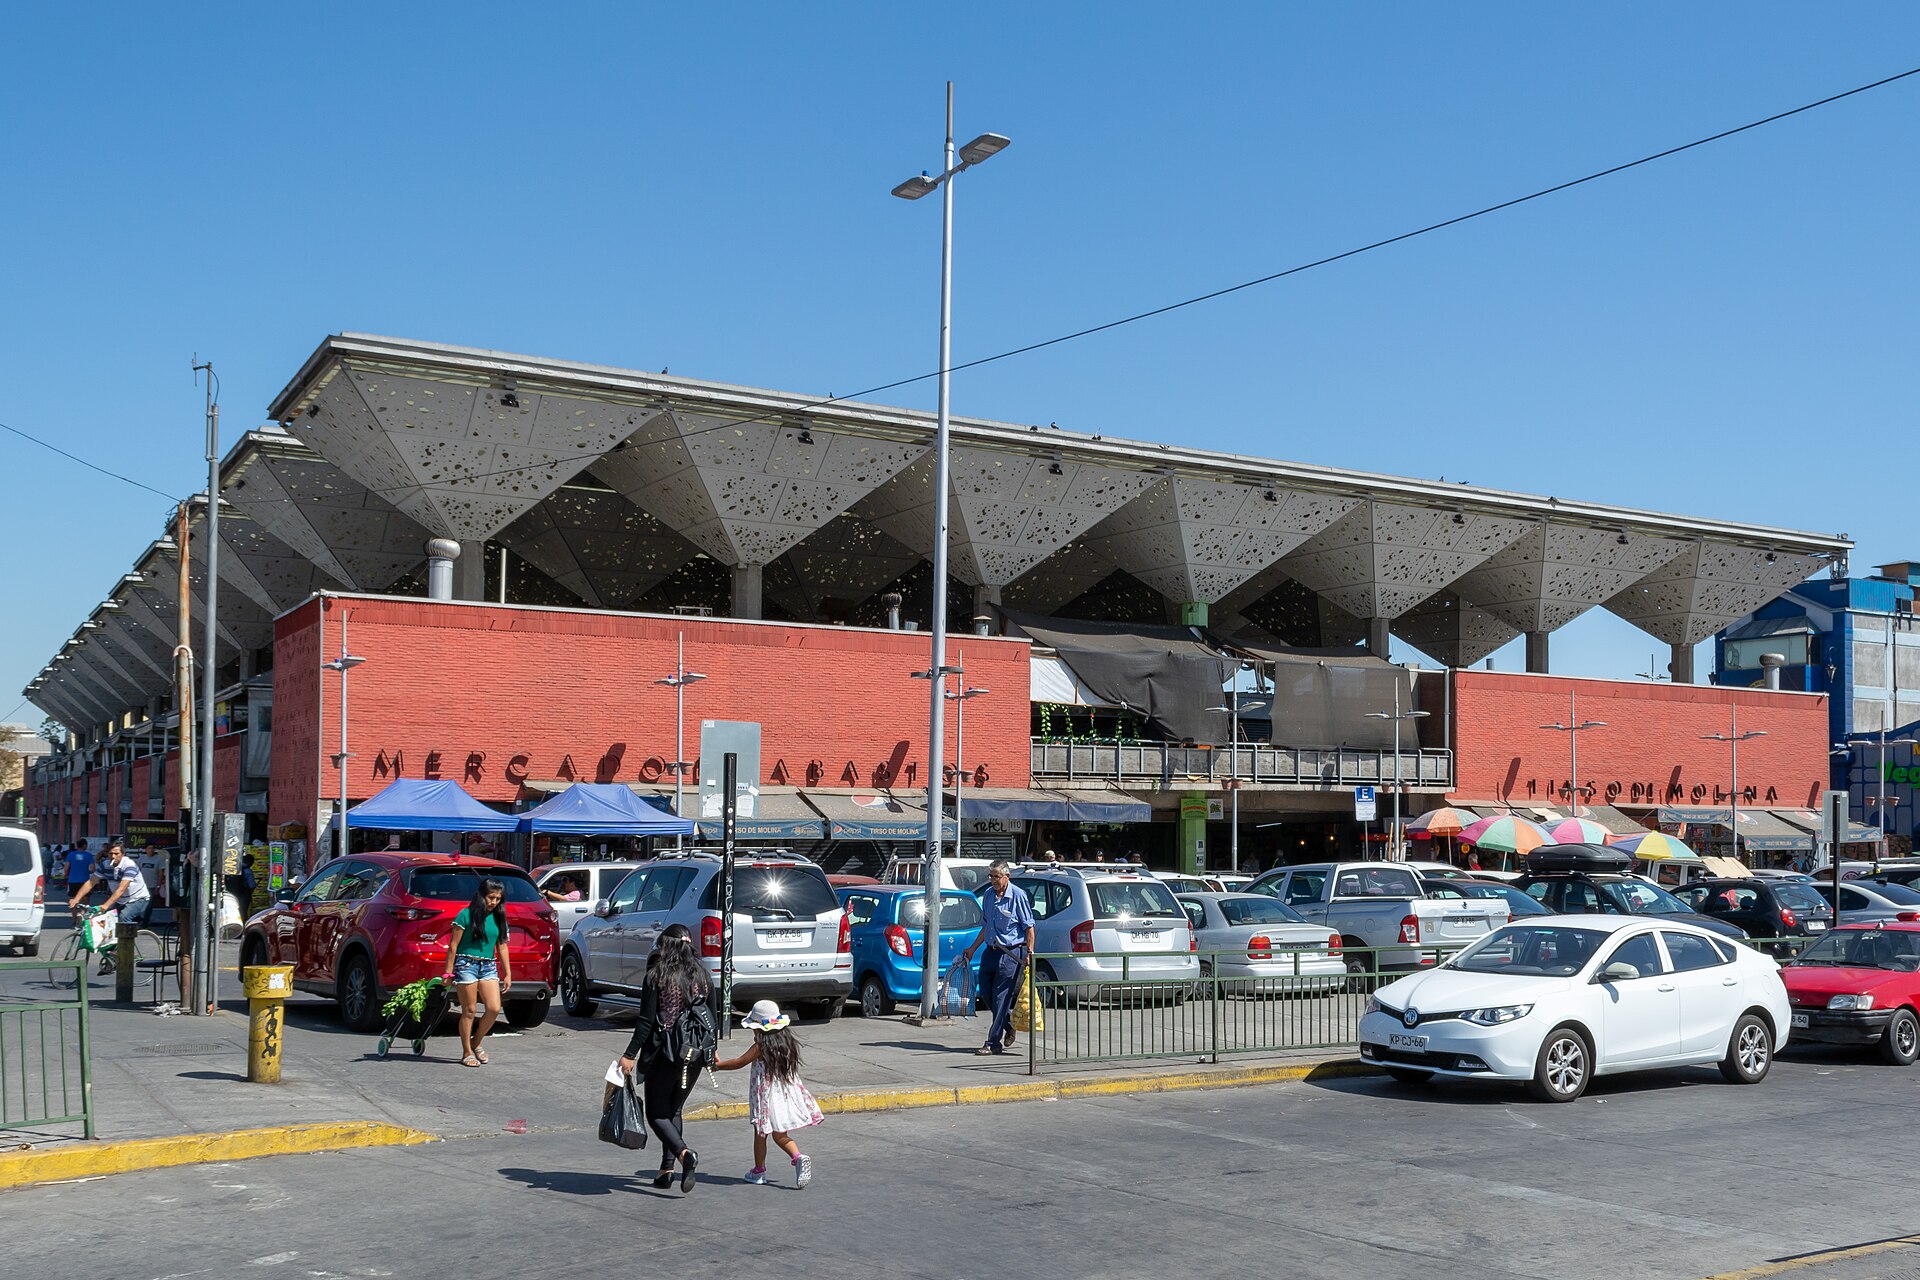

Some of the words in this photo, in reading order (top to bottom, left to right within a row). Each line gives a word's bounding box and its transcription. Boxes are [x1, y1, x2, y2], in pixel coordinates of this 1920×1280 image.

[373, 748, 666, 784] MERCADO
[1361, 788, 1369, 799] E
[1667, 783, 1778, 805] MOLNA
[1010, 821, 1022, 829] 110
